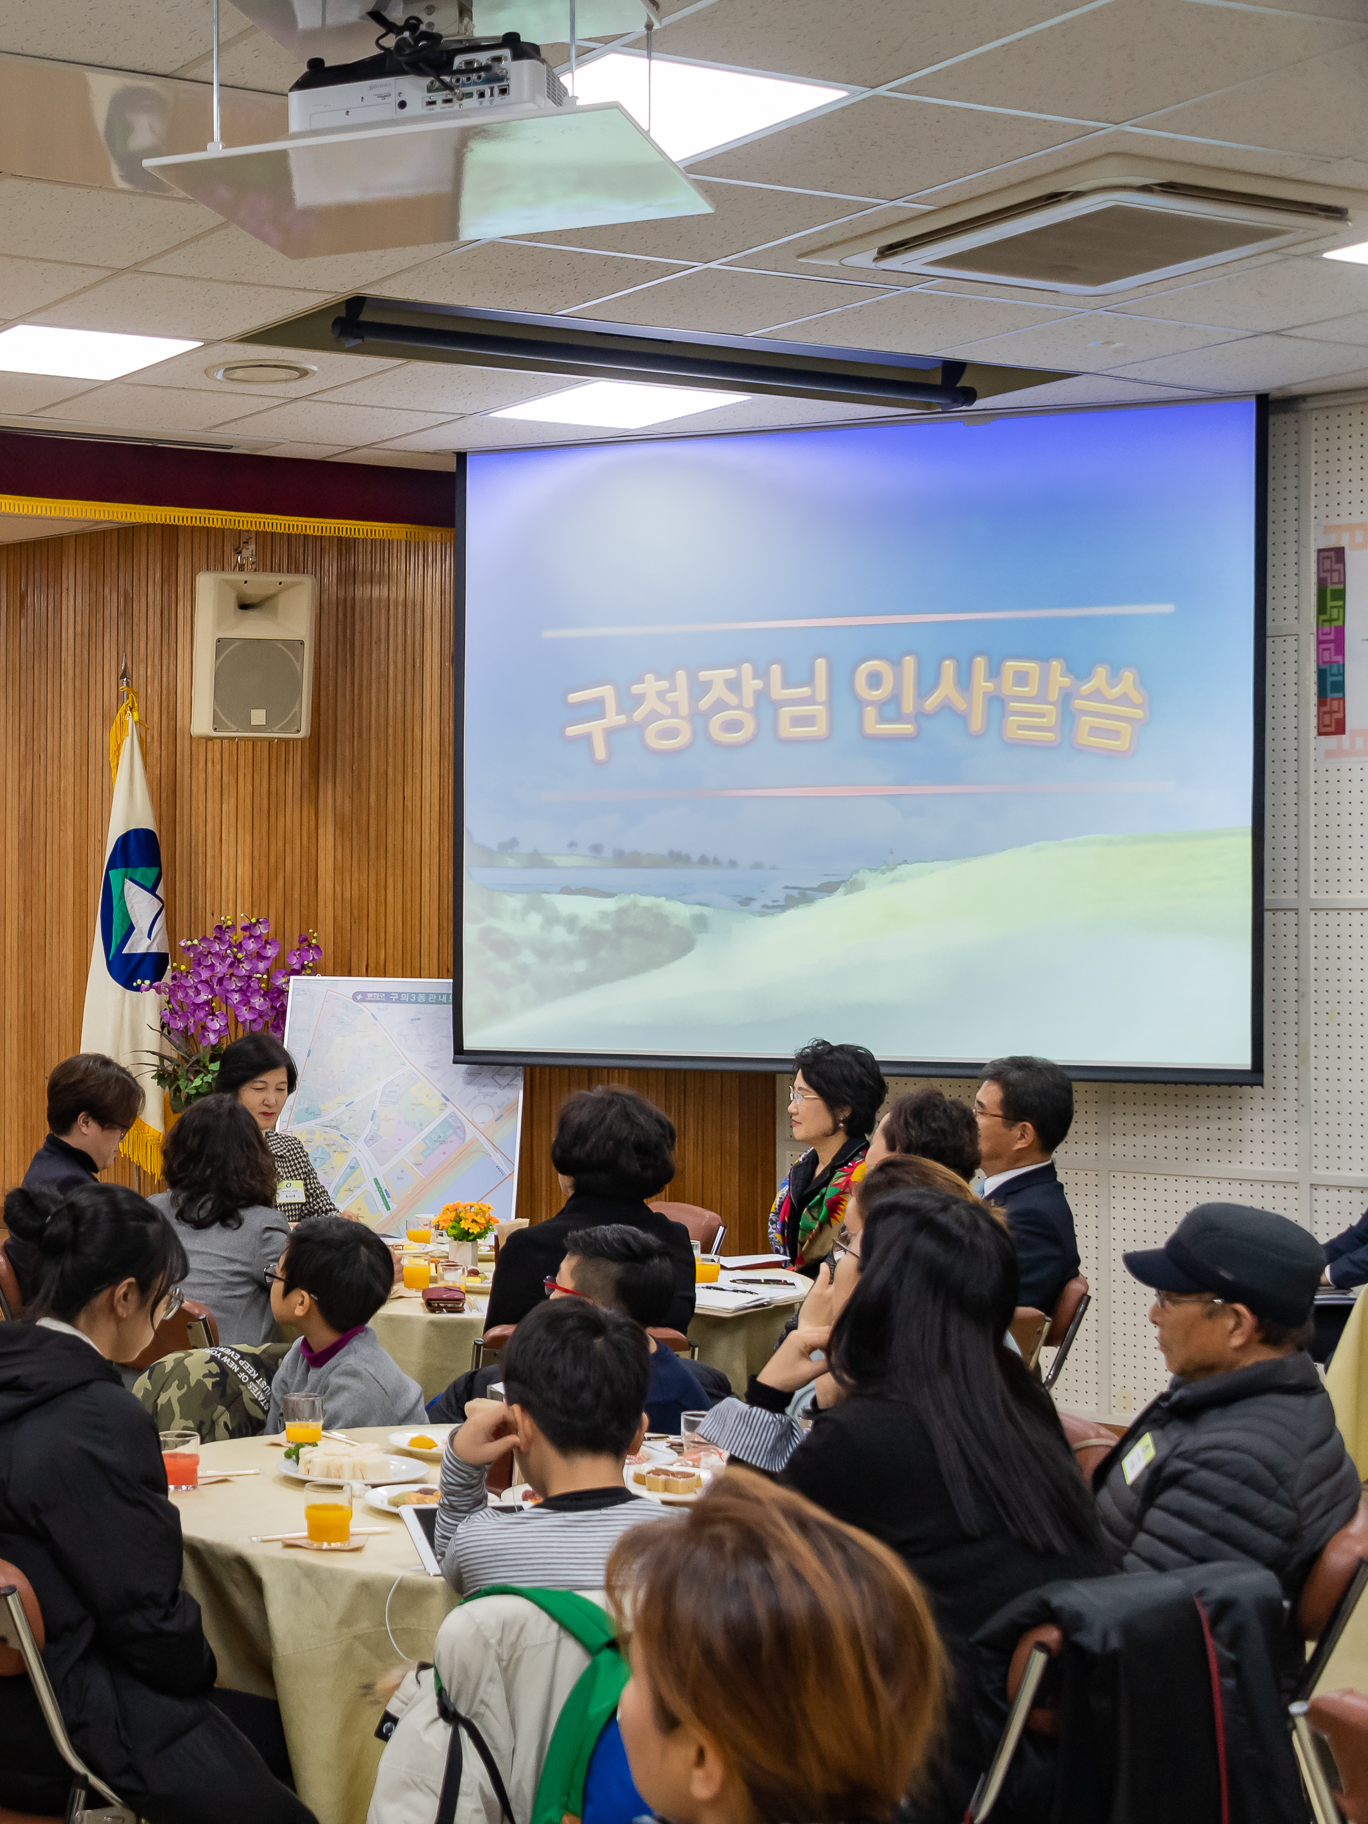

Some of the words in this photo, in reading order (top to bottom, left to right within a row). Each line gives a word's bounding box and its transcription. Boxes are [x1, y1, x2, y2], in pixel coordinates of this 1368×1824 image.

[564, 656, 830, 762] 구청장님
[853, 655, 1146, 754] 인사말씀
[221, 1356, 240, 1373] NEW
[238, 1360, 259, 1379] KEEP
[237, 1372, 249, 1383] OF
[247, 1381, 269, 1411] STATES
